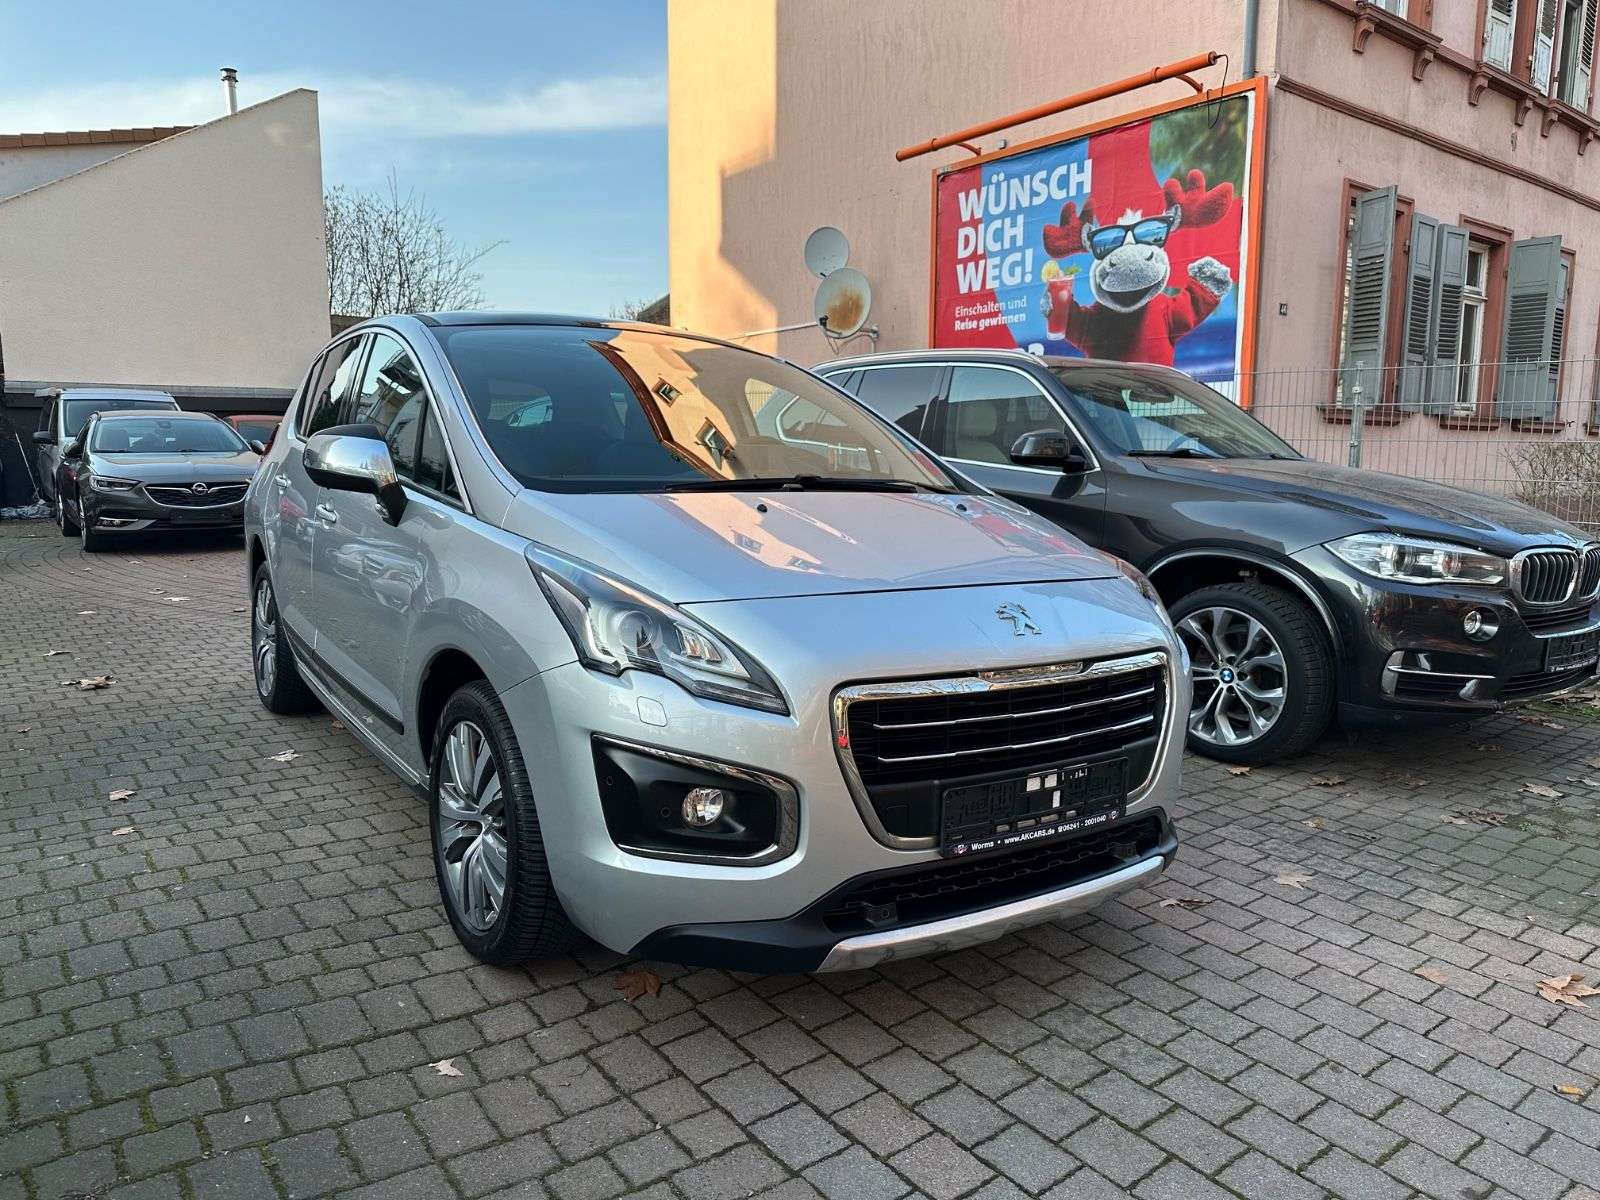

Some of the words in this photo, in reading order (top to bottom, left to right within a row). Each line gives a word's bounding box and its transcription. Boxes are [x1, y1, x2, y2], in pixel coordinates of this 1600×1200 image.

[958, 159, 1092, 222] WÜNSCH
[957, 214, 1024, 259] DICH
[956, 248, 1033, 294] WEG!
[955, 301, 1005, 318] Einschalten
[1008, 295, 1027, 310] und
[955, 319, 977, 331] Reise
[979, 313, 1026, 330] gewinnen
[971, 841, 994, 850] Worms
[1004, 828, 1055, 844] www.AKCARS.de
